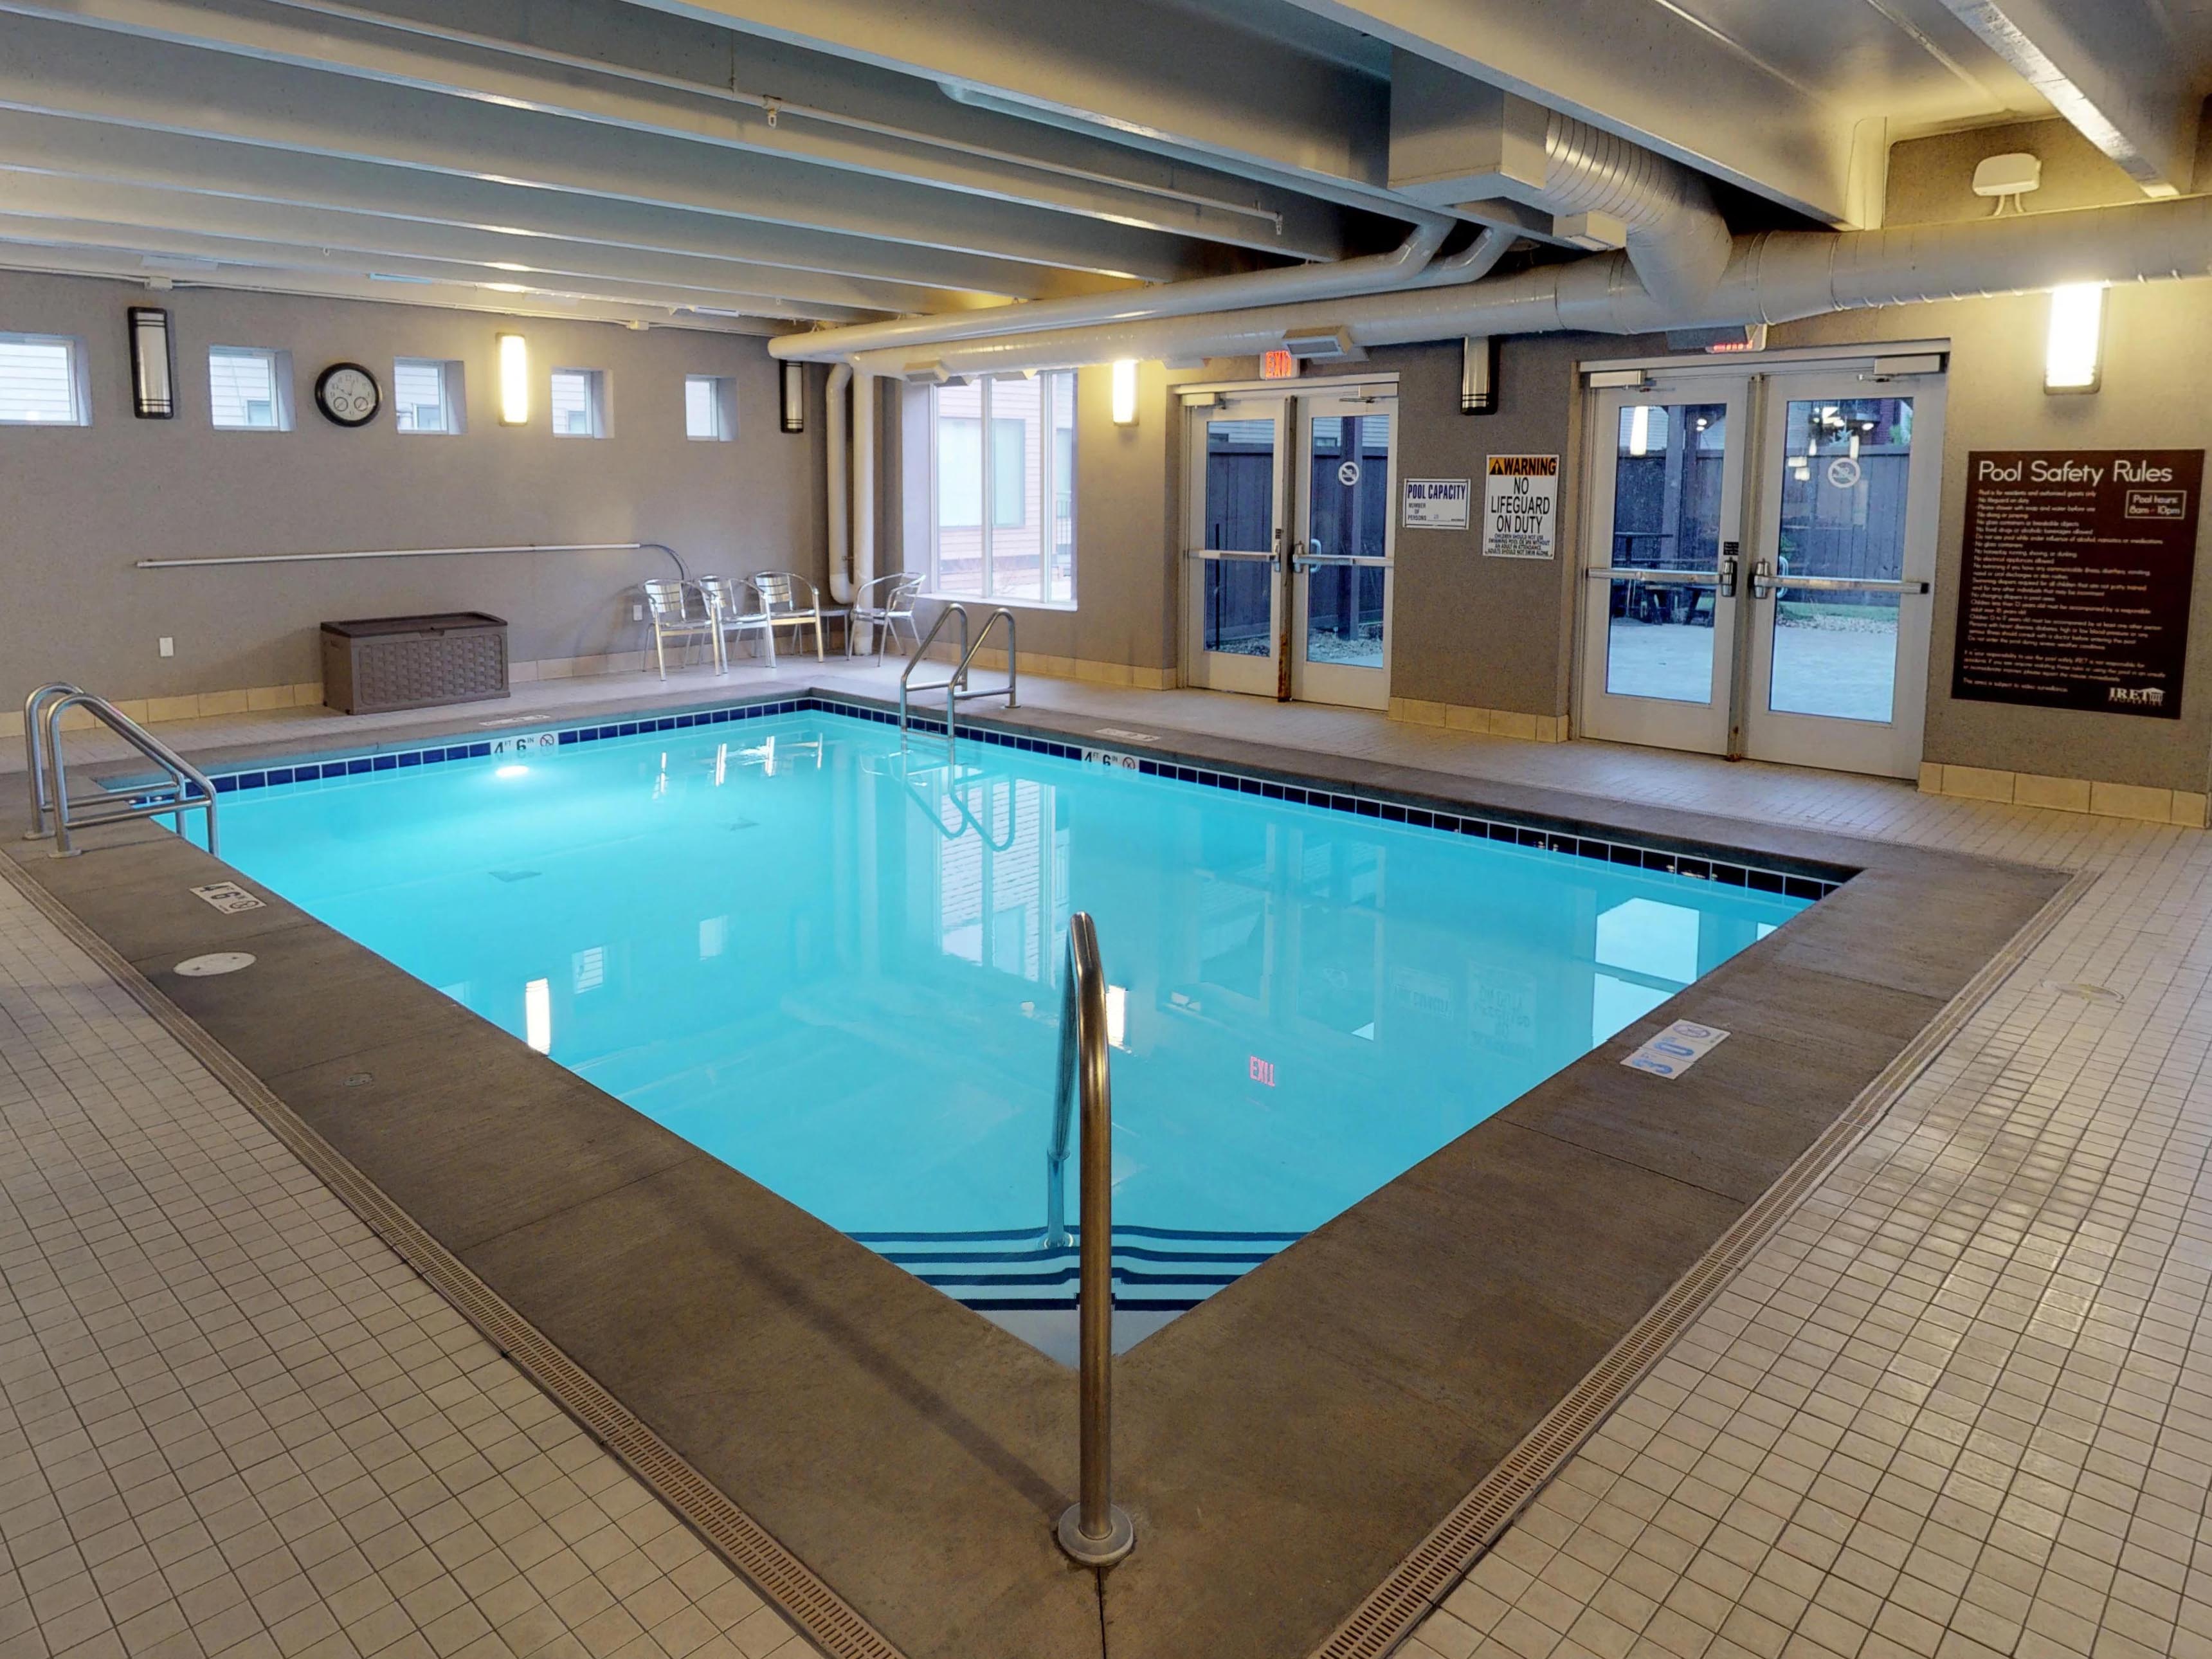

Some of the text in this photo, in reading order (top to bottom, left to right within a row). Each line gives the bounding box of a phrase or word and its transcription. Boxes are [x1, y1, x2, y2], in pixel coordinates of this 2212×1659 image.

[1503, 457, 1557, 476] WARNING
[1978, 460, 2173, 487] Pool Safety Rules
[1408, 484, 1466, 500] POOL CAPACITY
[1514, 477, 1529, 494] NO
[1491, 496, 1550, 515] LIFEGUARD
[2132, 494, 2153, 503] Pool
[2129, 505, 2150, 514] 8am
[2157, 505, 2181, 515] 10pm
[1496, 515, 1543, 534] ON DUTY
[2109, 687, 2148, 702] IRET
[494, 741, 503, 754] 4
[516, 739, 527, 751] 6
[1085, 751, 1092, 763] 4
[1103, 754, 1111, 766] 6
[1631, 1058, 1673, 1074] 3
